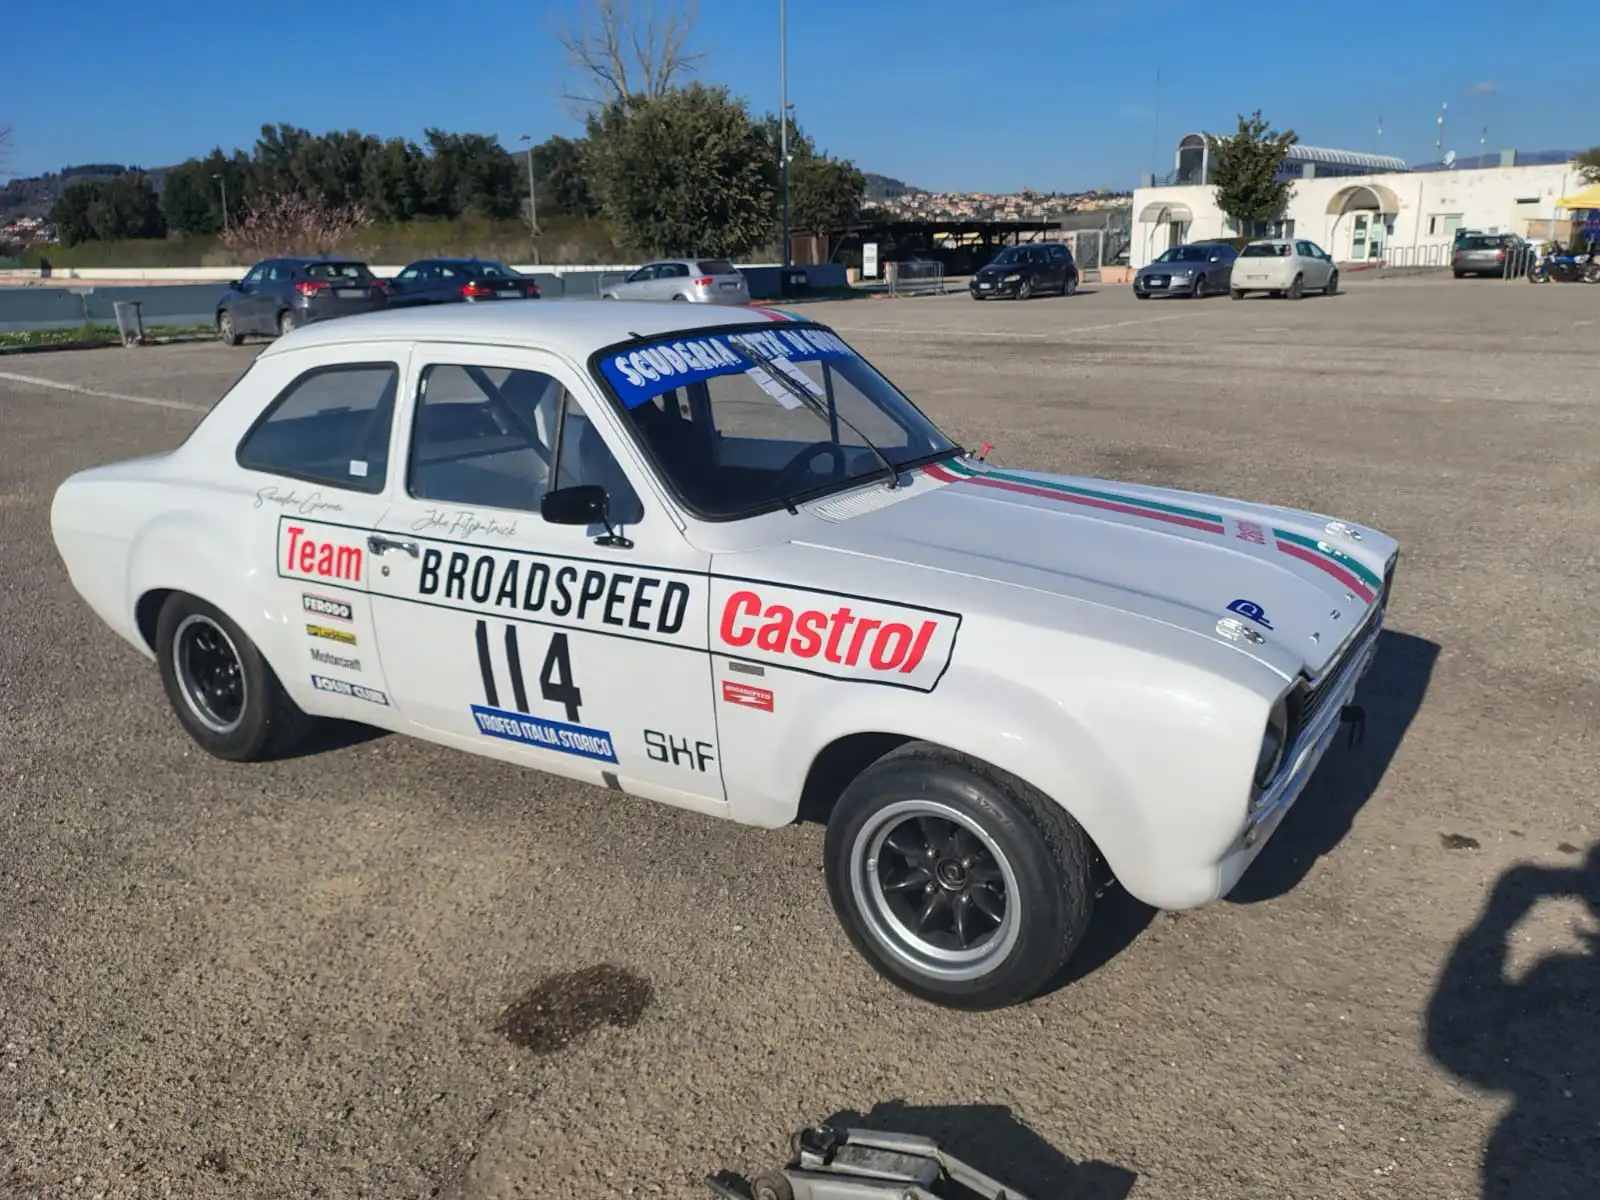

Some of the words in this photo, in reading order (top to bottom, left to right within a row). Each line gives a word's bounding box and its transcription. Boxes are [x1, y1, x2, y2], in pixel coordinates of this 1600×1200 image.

[614, 337, 742, 388] SCUDERIA
[287, 526, 362, 581] Team
[303, 597, 350, 618] FERODO
[419, 549, 690, 635] BROADSPEED
[719, 590, 938, 674] Castrol
[310, 648, 362, 672] Motorcraft
[475, 619, 583, 723] 114
[475, 711, 519, 738] TROFEO
[520, 722, 559, 746] ITALIA
[559, 729, 613, 757] STORICO
[643, 728, 715, 772] SKF
